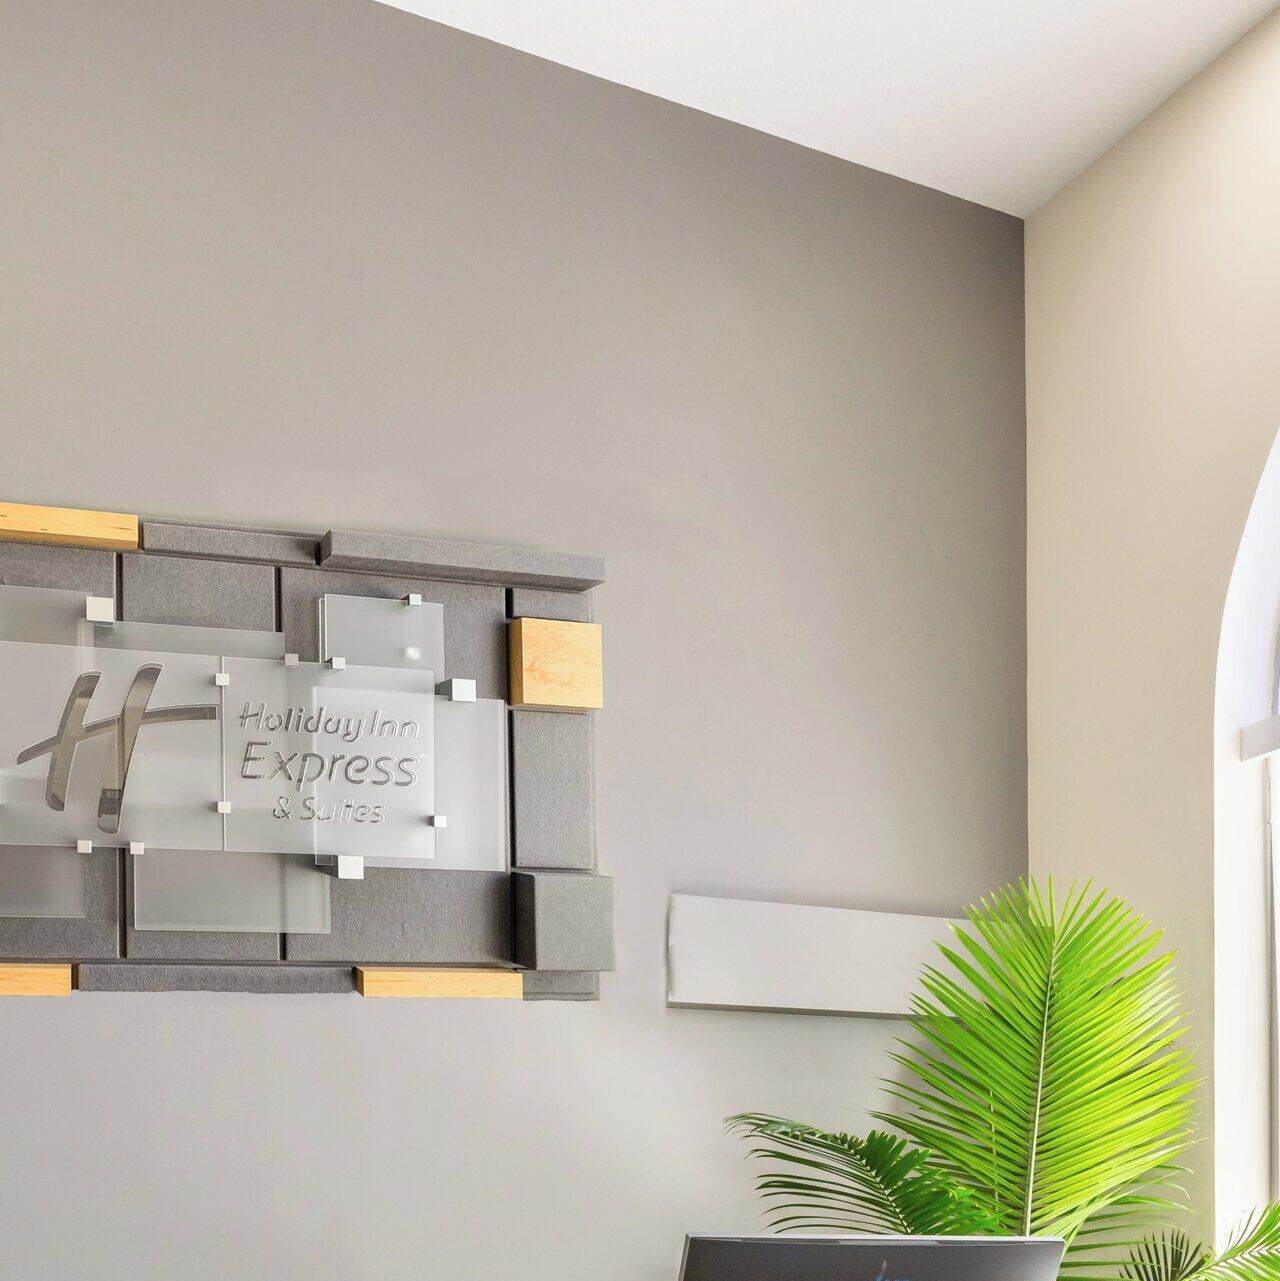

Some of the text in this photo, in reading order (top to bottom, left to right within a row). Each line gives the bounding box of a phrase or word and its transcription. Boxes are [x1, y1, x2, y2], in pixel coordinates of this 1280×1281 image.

[239, 701, 420, 743] Holiday Inn
[240, 741, 420, 793] Express
[271, 796, 386, 823] & Suites
